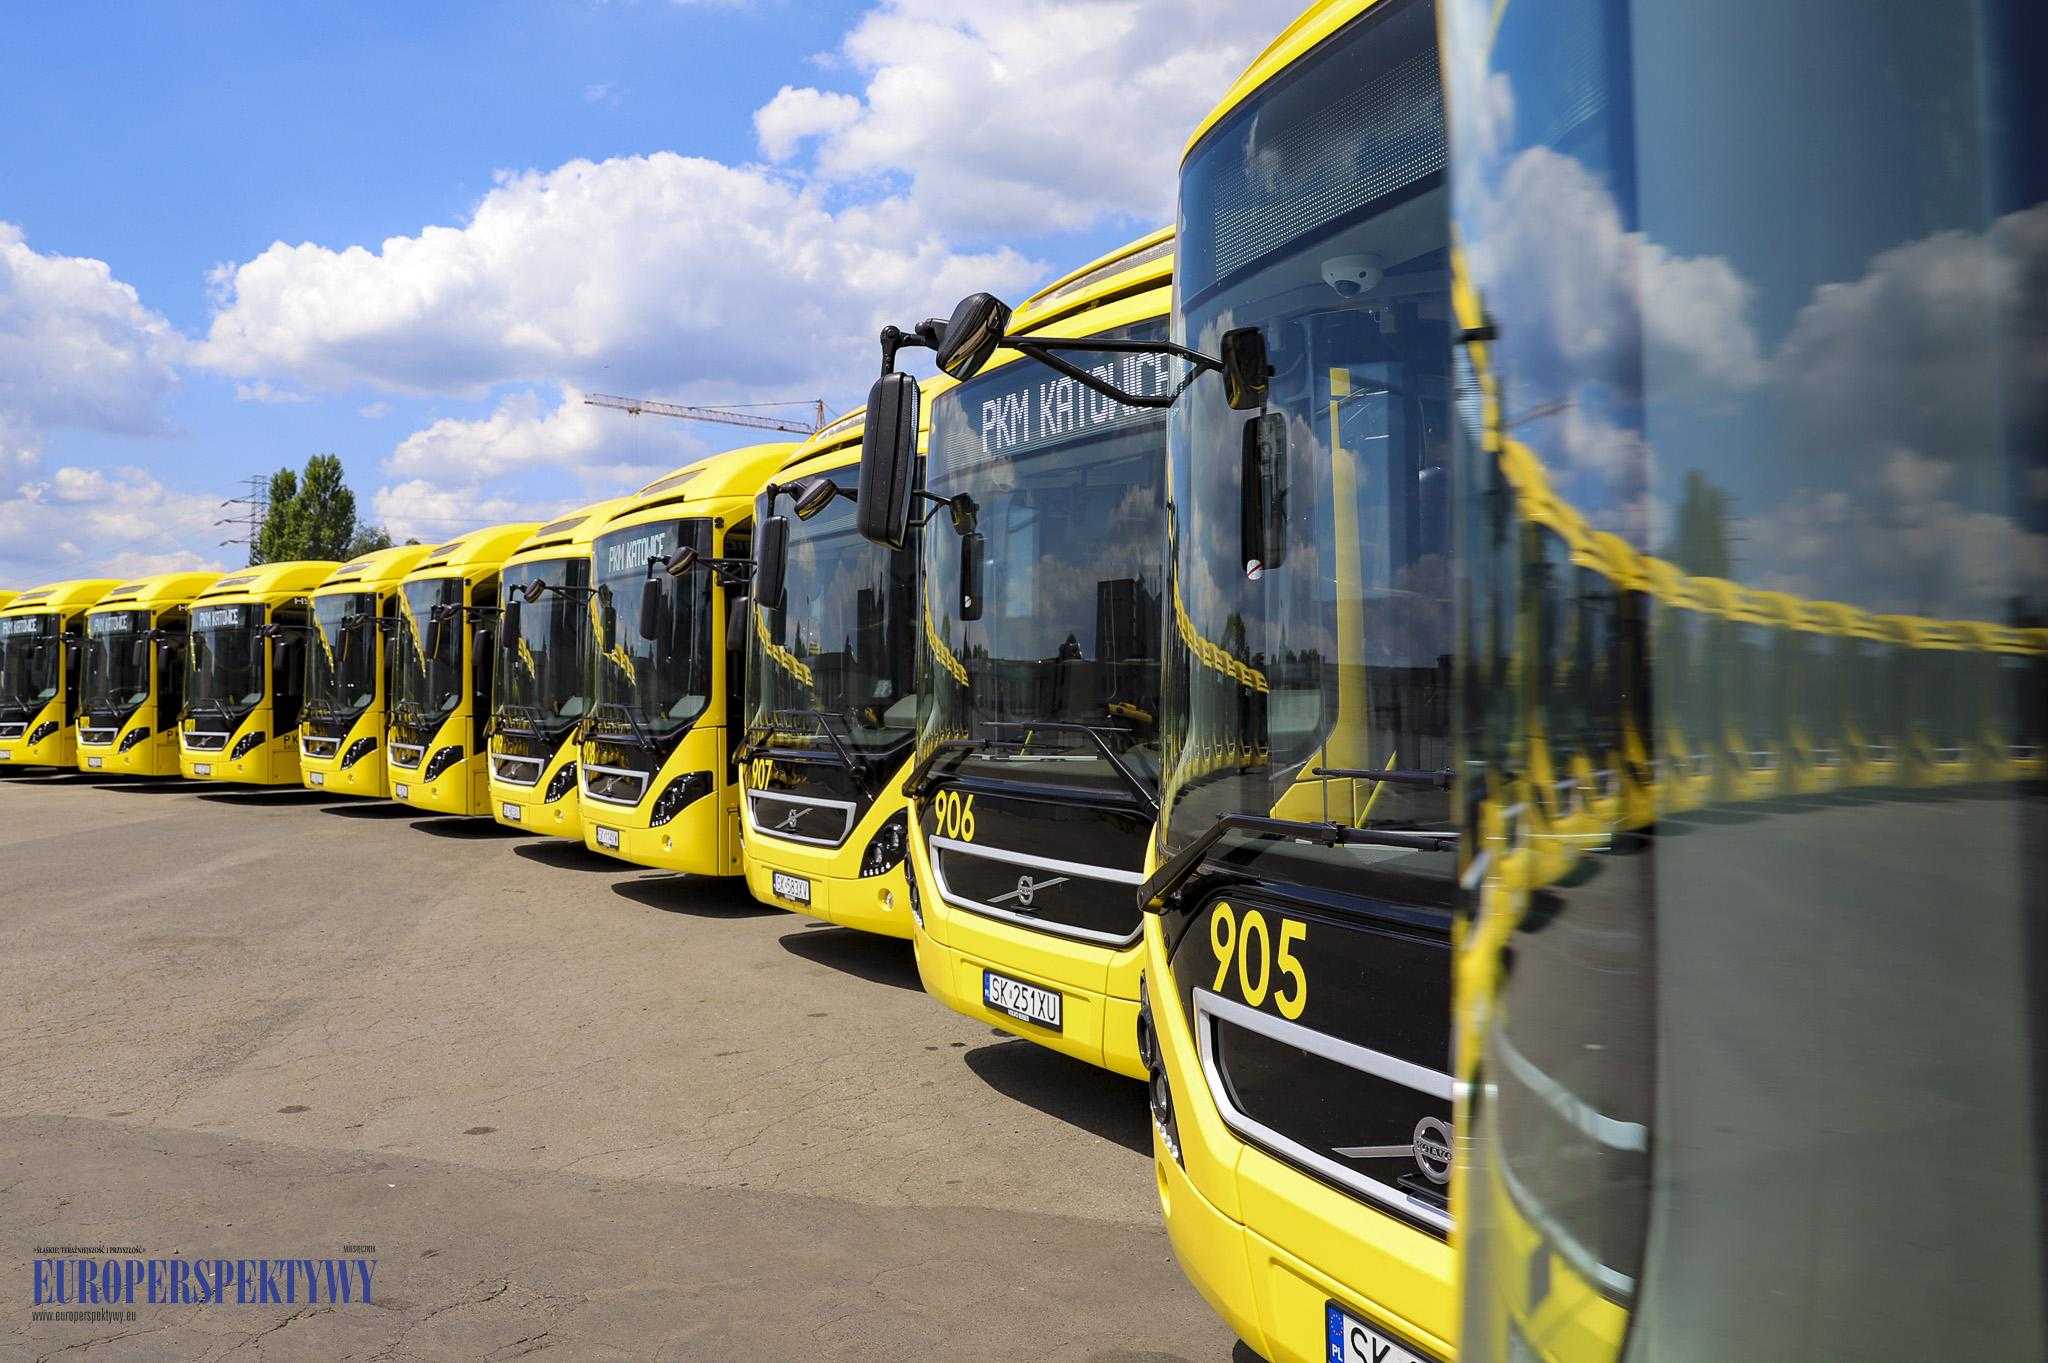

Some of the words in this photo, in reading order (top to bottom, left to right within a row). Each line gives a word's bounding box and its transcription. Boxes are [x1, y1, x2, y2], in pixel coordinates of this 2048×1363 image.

[981, 388, 1030, 454] PKM
[608, 543, 625, 573] PKM
[751, 757, 773, 790] 907
[935, 790, 975, 842] 906
[1210, 902, 1307, 1020] 905
[992, 977, 1009, 1006] SK
[1013, 985, 1056, 1022] 251XU
[1416, 1140, 1453, 1161] VOLVO
[1331, 1343, 1343, 1362] PL
